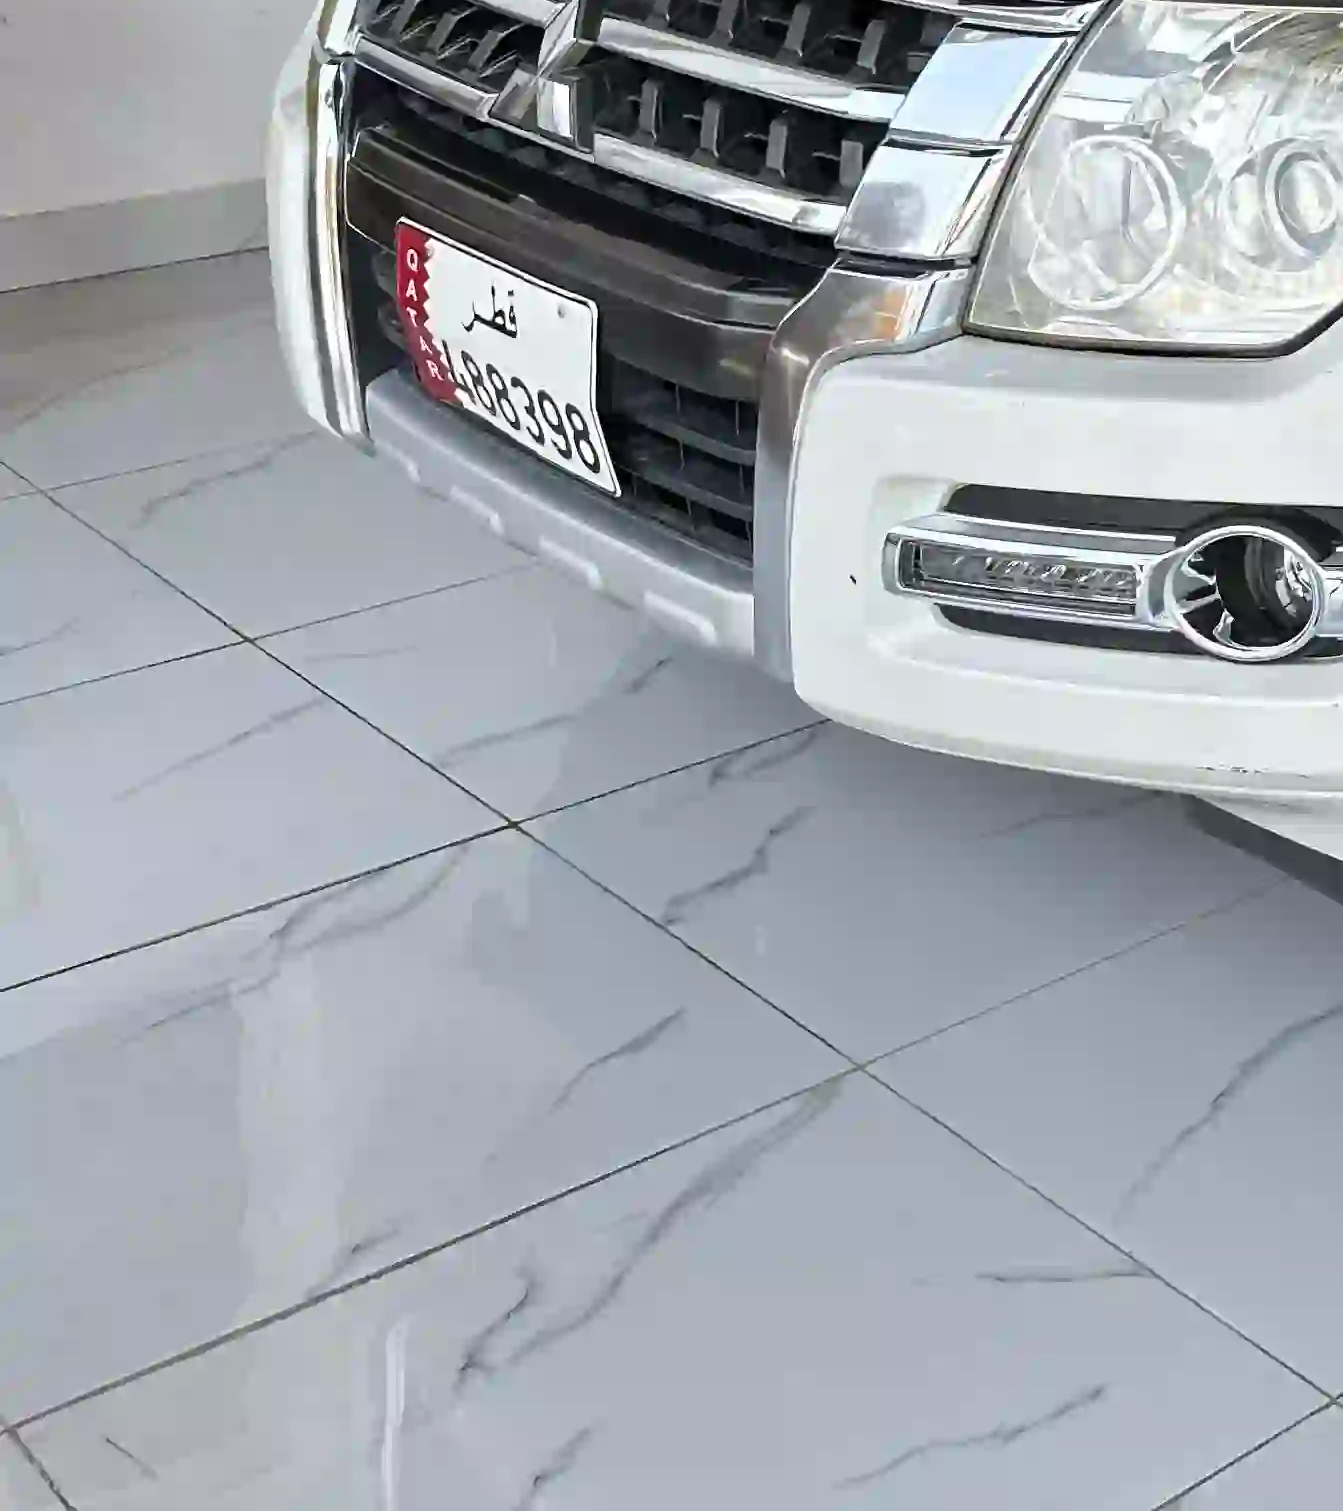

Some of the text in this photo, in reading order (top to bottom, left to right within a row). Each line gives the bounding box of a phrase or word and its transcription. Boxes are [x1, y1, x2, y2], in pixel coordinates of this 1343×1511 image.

[405, 248, 444, 381] QATAR
[460, 280, 518, 339] قطر
[441, 339, 601, 474] 488398
